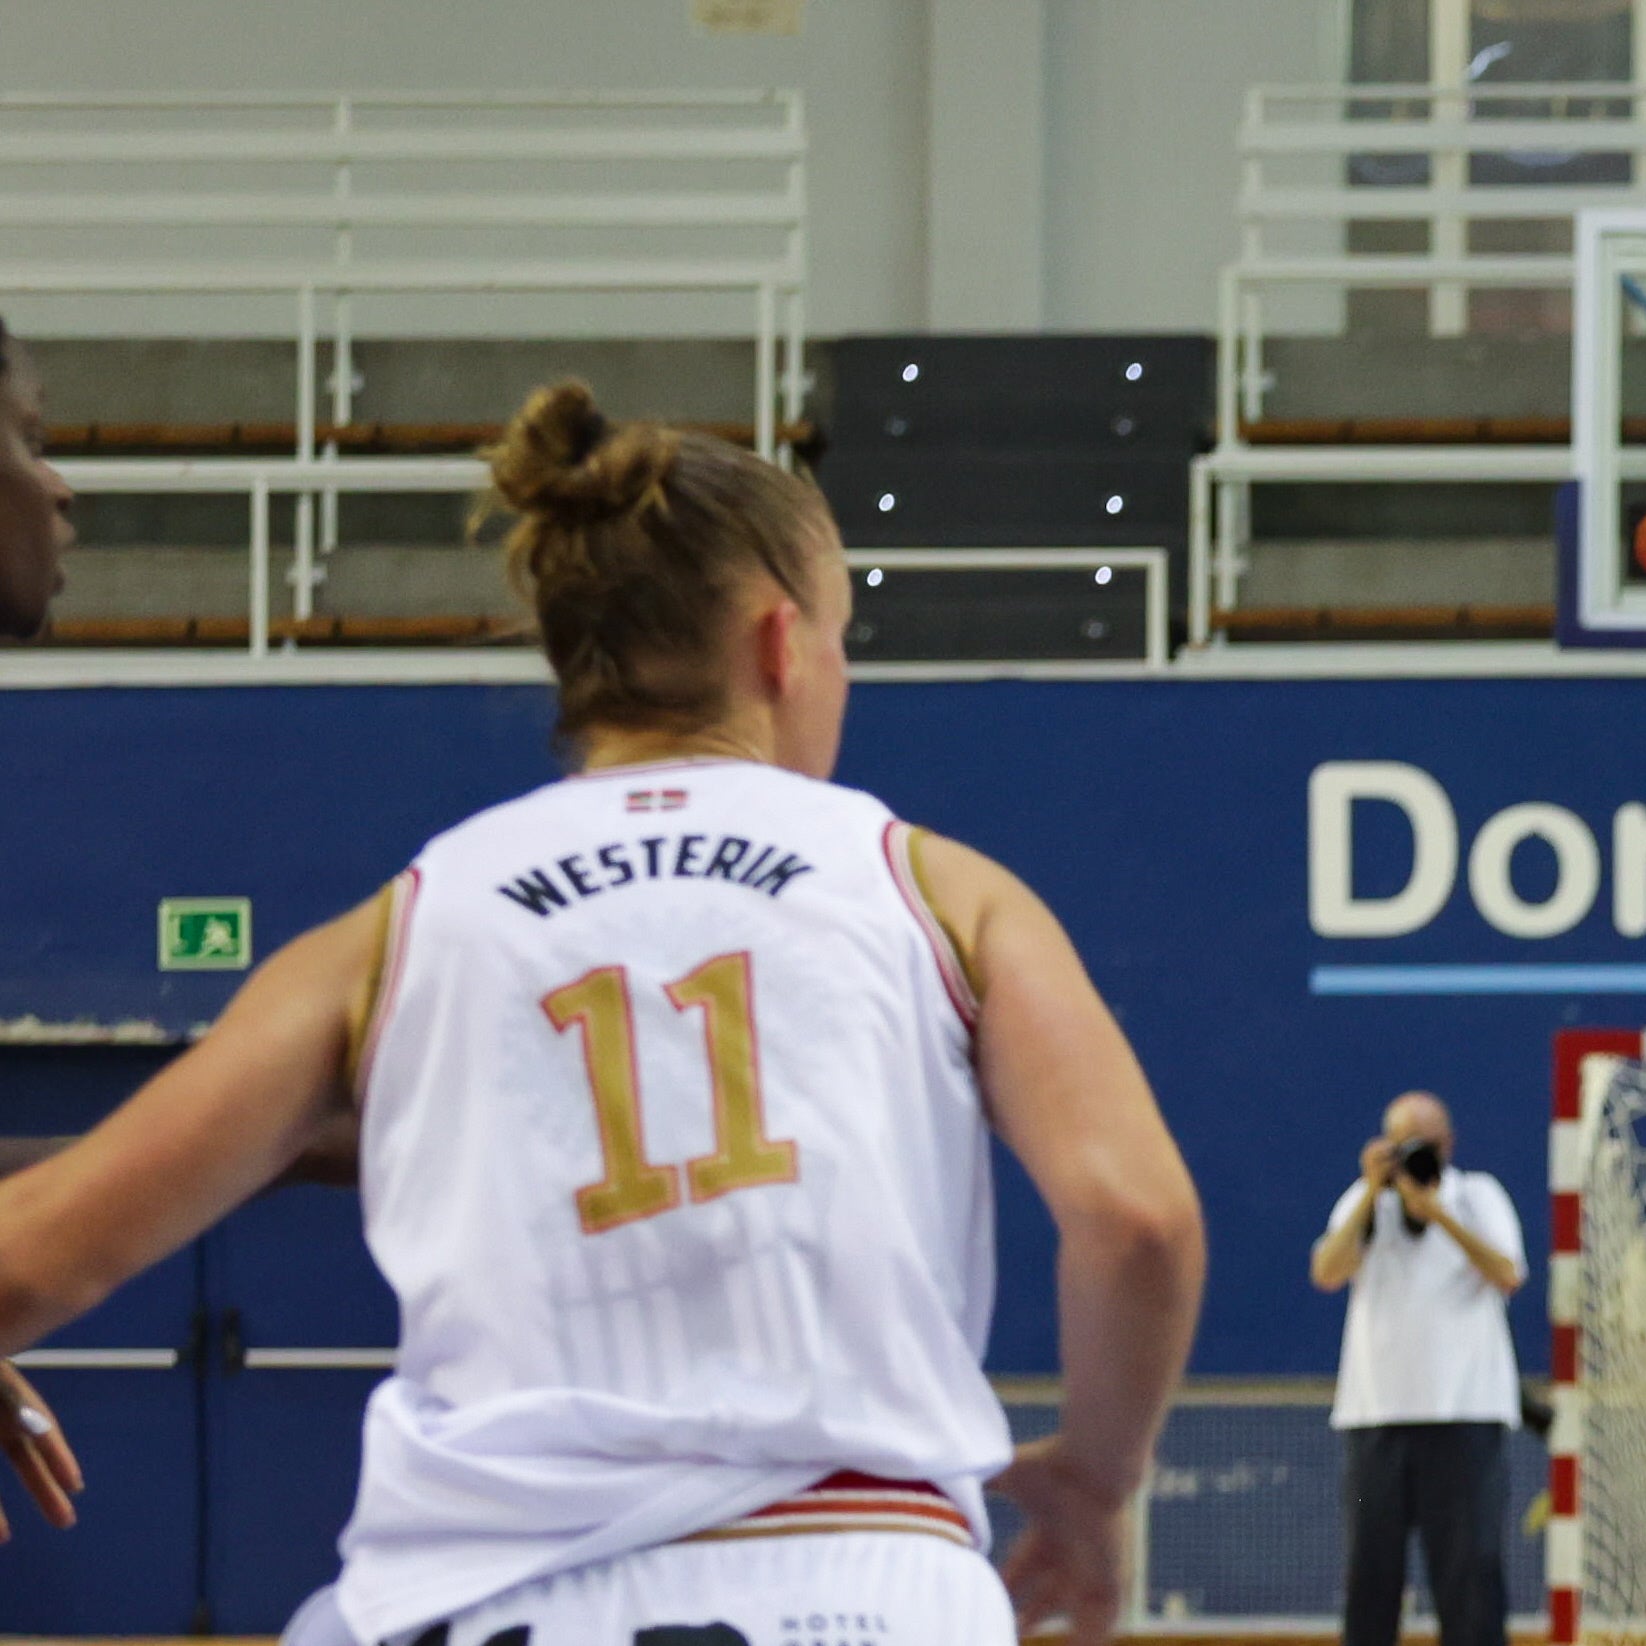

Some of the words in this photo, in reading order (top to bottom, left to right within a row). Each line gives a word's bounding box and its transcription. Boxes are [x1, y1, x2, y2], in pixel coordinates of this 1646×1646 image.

[495, 834, 815, 918] WESTERIK
[540, 950, 800, 1236] 11
[781, 1613, 888, 1633] HOTEL
